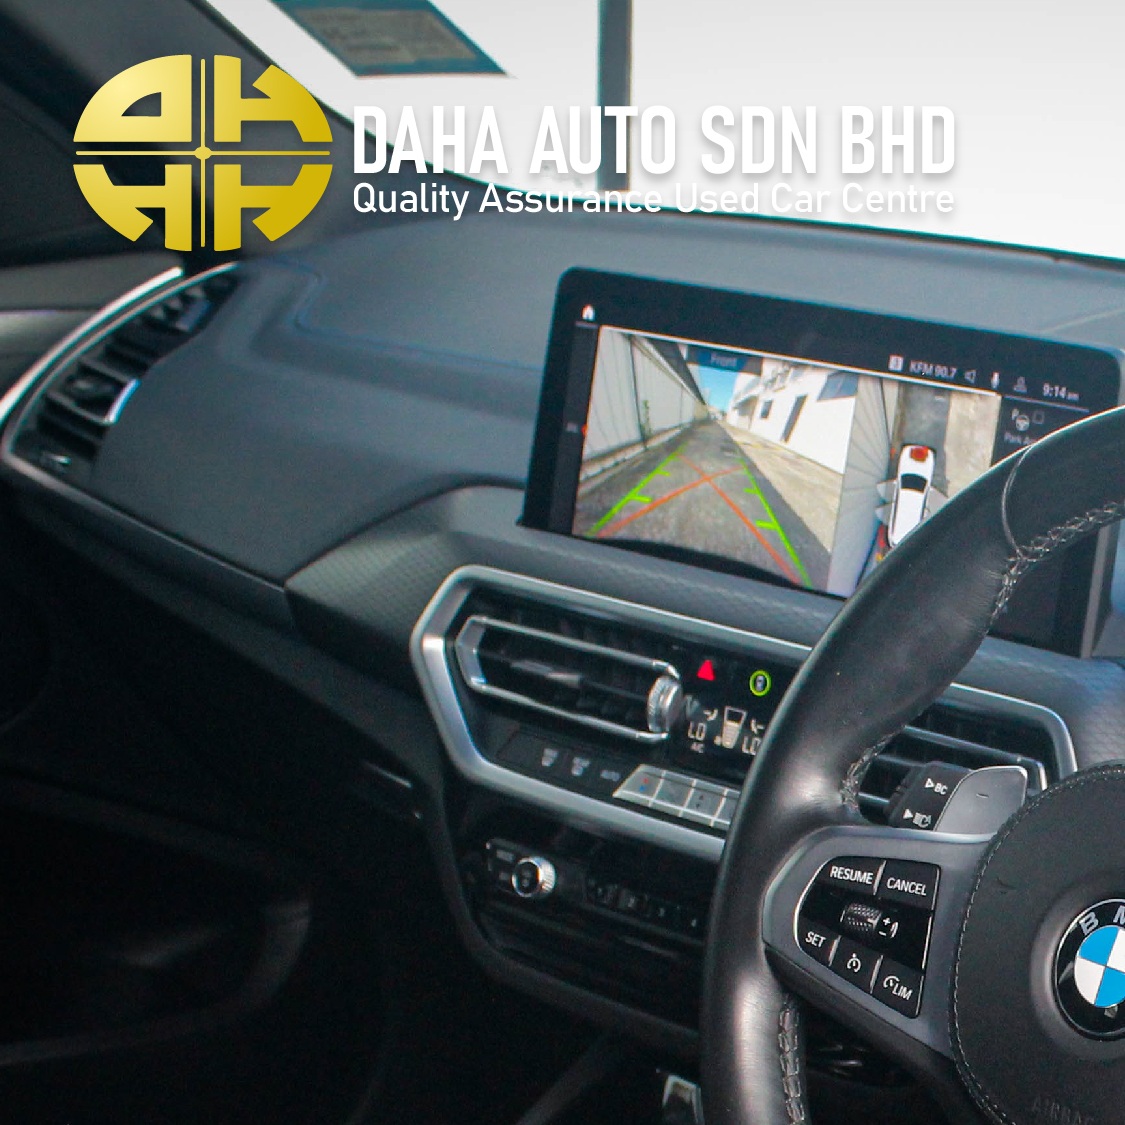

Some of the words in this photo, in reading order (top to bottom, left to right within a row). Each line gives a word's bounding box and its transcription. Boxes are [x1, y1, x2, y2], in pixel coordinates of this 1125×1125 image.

[910, 360, 934, 376] KFM
[935, 364, 957, 379] 90.7
[1043, 383, 1067, 399] 9:14
[934, 782, 949, 795] BC
[829, 865, 875, 885] RESUME
[886, 877, 927, 896] CANCEL
[805, 930, 827, 948] SET
[892, 982, 914, 1001] LIM
